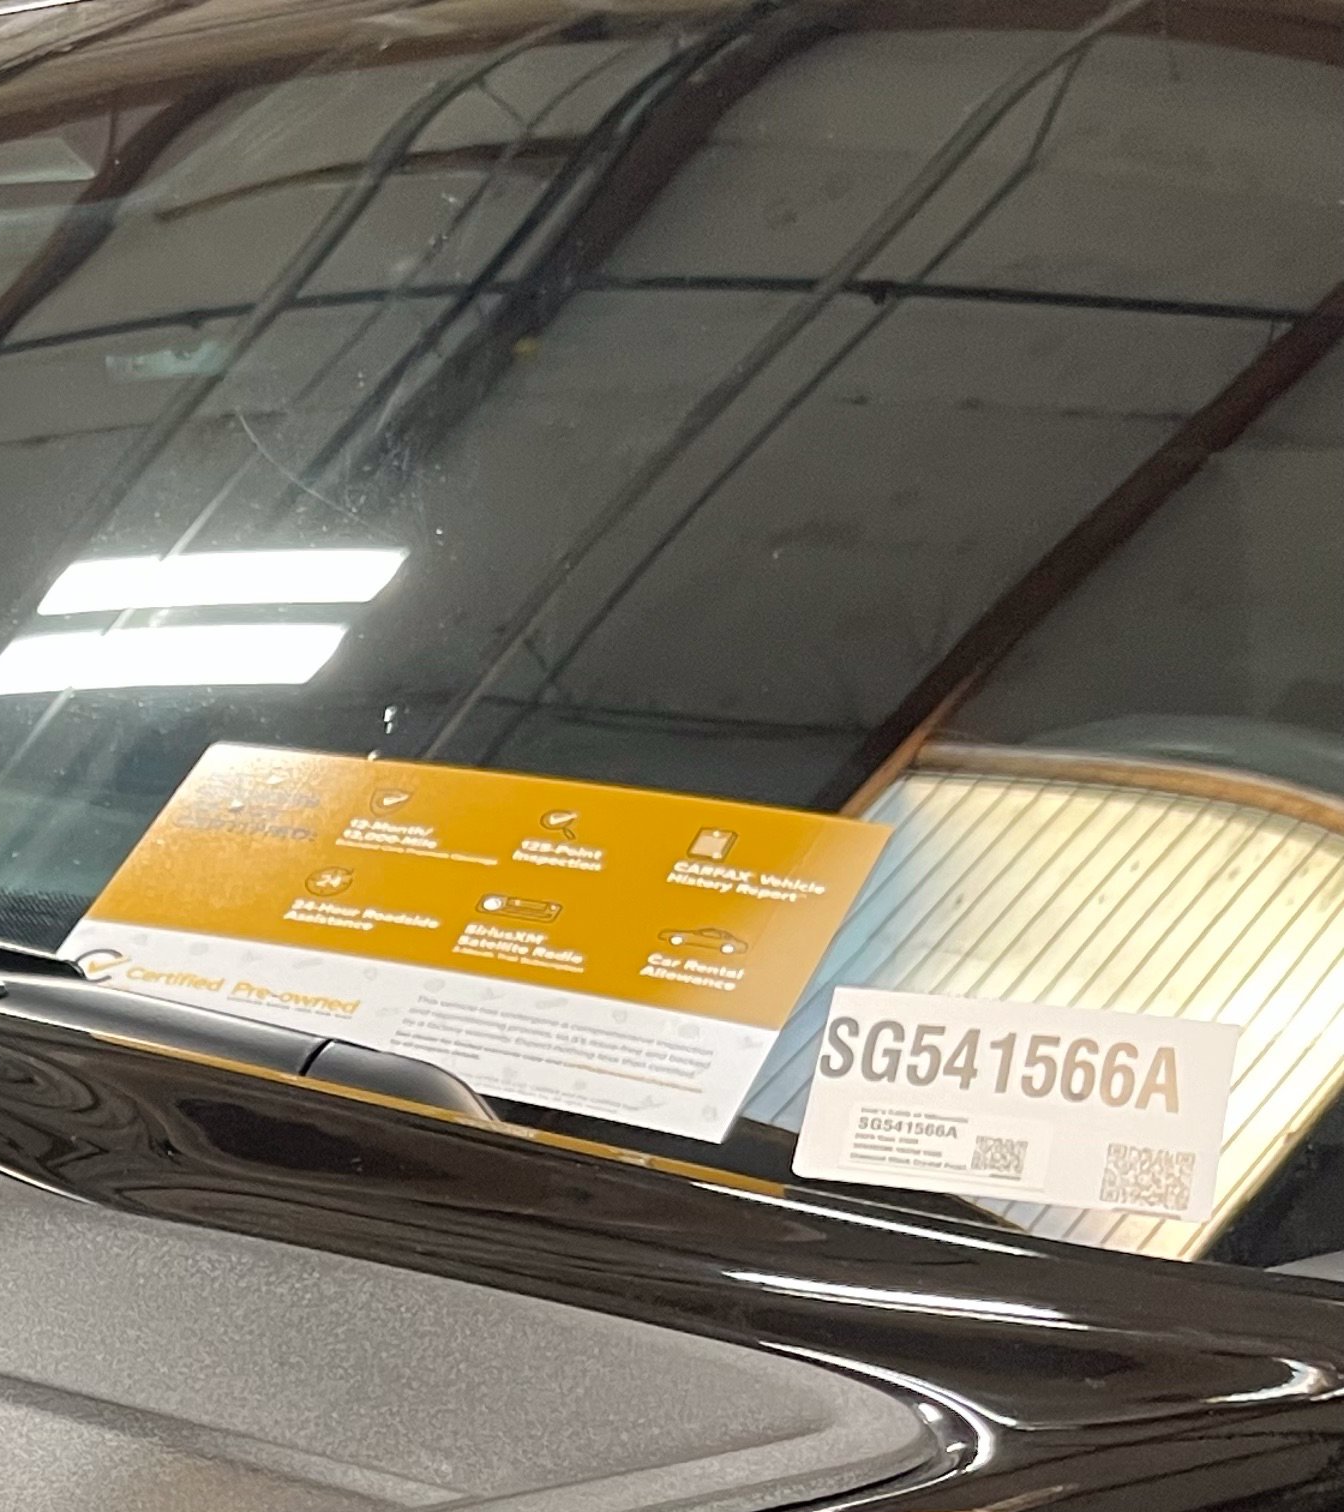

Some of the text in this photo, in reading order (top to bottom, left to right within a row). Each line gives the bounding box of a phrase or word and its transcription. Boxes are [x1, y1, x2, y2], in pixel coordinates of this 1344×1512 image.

[512, 850, 602, 872] Inspection
[666, 872, 733, 893] History
[760, 874, 826, 895] Vehicle
[283, 910, 374, 931] Assistance
[290, 898, 440, 929] 24-Hour Roadside
[457, 935, 529, 955] Satellite
[531, 946, 584, 964] Radio
[639, 965, 737, 992] Allowance
[647, 952, 745, 980] Car Rental
[126, 966, 226, 993] Certified
[231, 980, 362, 1016] Pre-owned
[819, 1016, 1180, 1114] SG541566A
